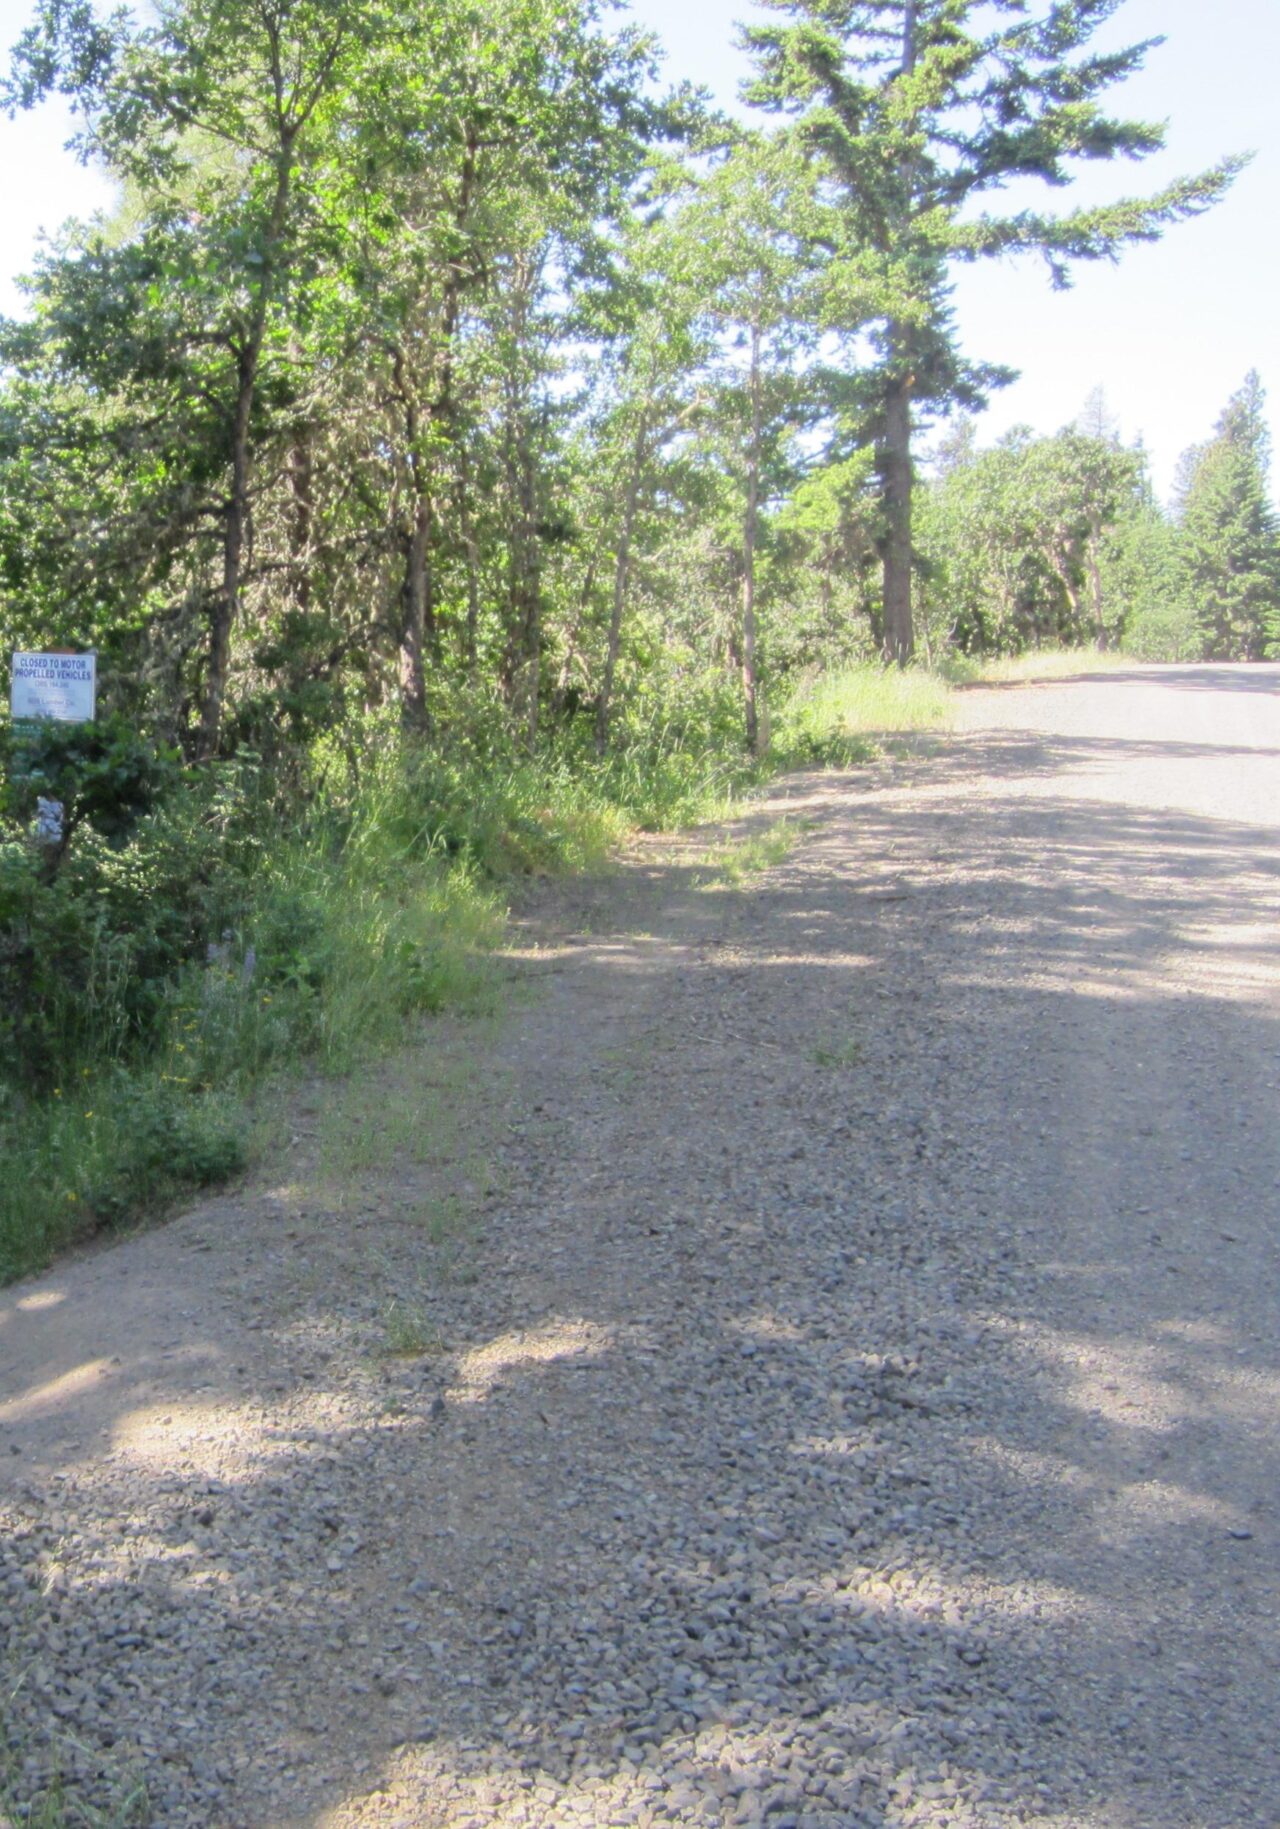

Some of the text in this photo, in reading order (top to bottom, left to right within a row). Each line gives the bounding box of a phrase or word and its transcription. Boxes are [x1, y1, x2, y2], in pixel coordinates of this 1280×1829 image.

[20, 658, 86, 669] CLOSED TO MOTOR
[15, 668, 91, 680] PROPELLED VEHICLES
